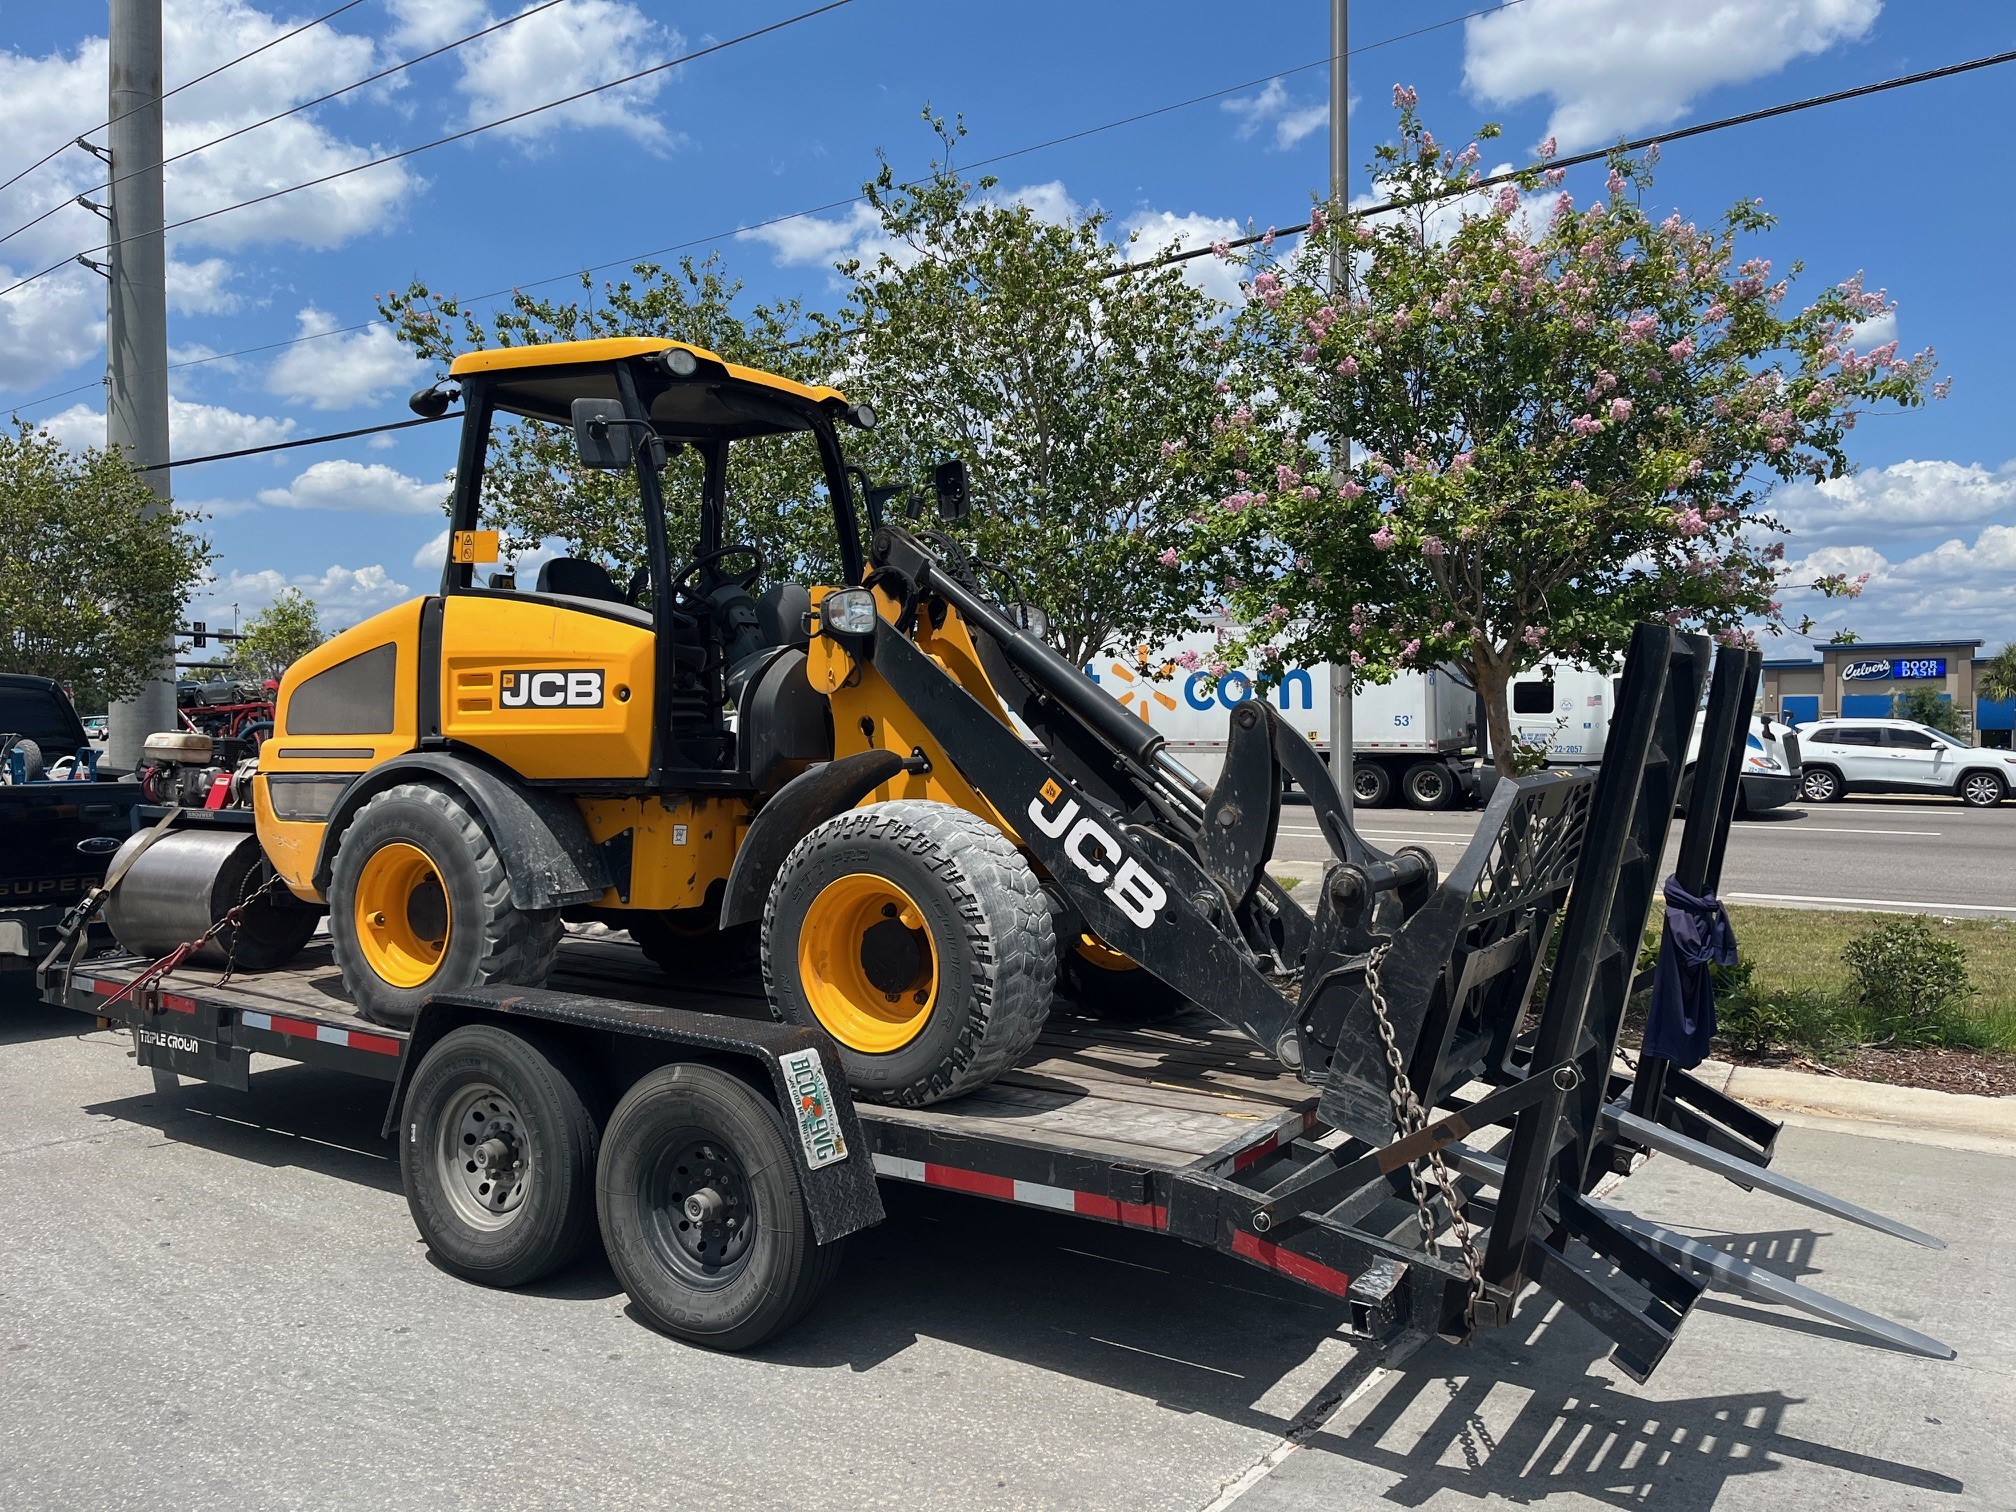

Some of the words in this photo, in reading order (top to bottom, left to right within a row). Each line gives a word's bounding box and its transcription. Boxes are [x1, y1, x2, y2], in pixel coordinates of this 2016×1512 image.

[1842, 660, 1890, 681] Culver's
[1902, 668, 1936, 677] DASH
[502, 673, 602, 706] JCB
[1027, 797, 1168, 929] JCB
[139, 1029, 167, 1047] TRIPLE
[167, 1034, 199, 1054] CROWN
[807, 1118, 836, 1161] 9VG
